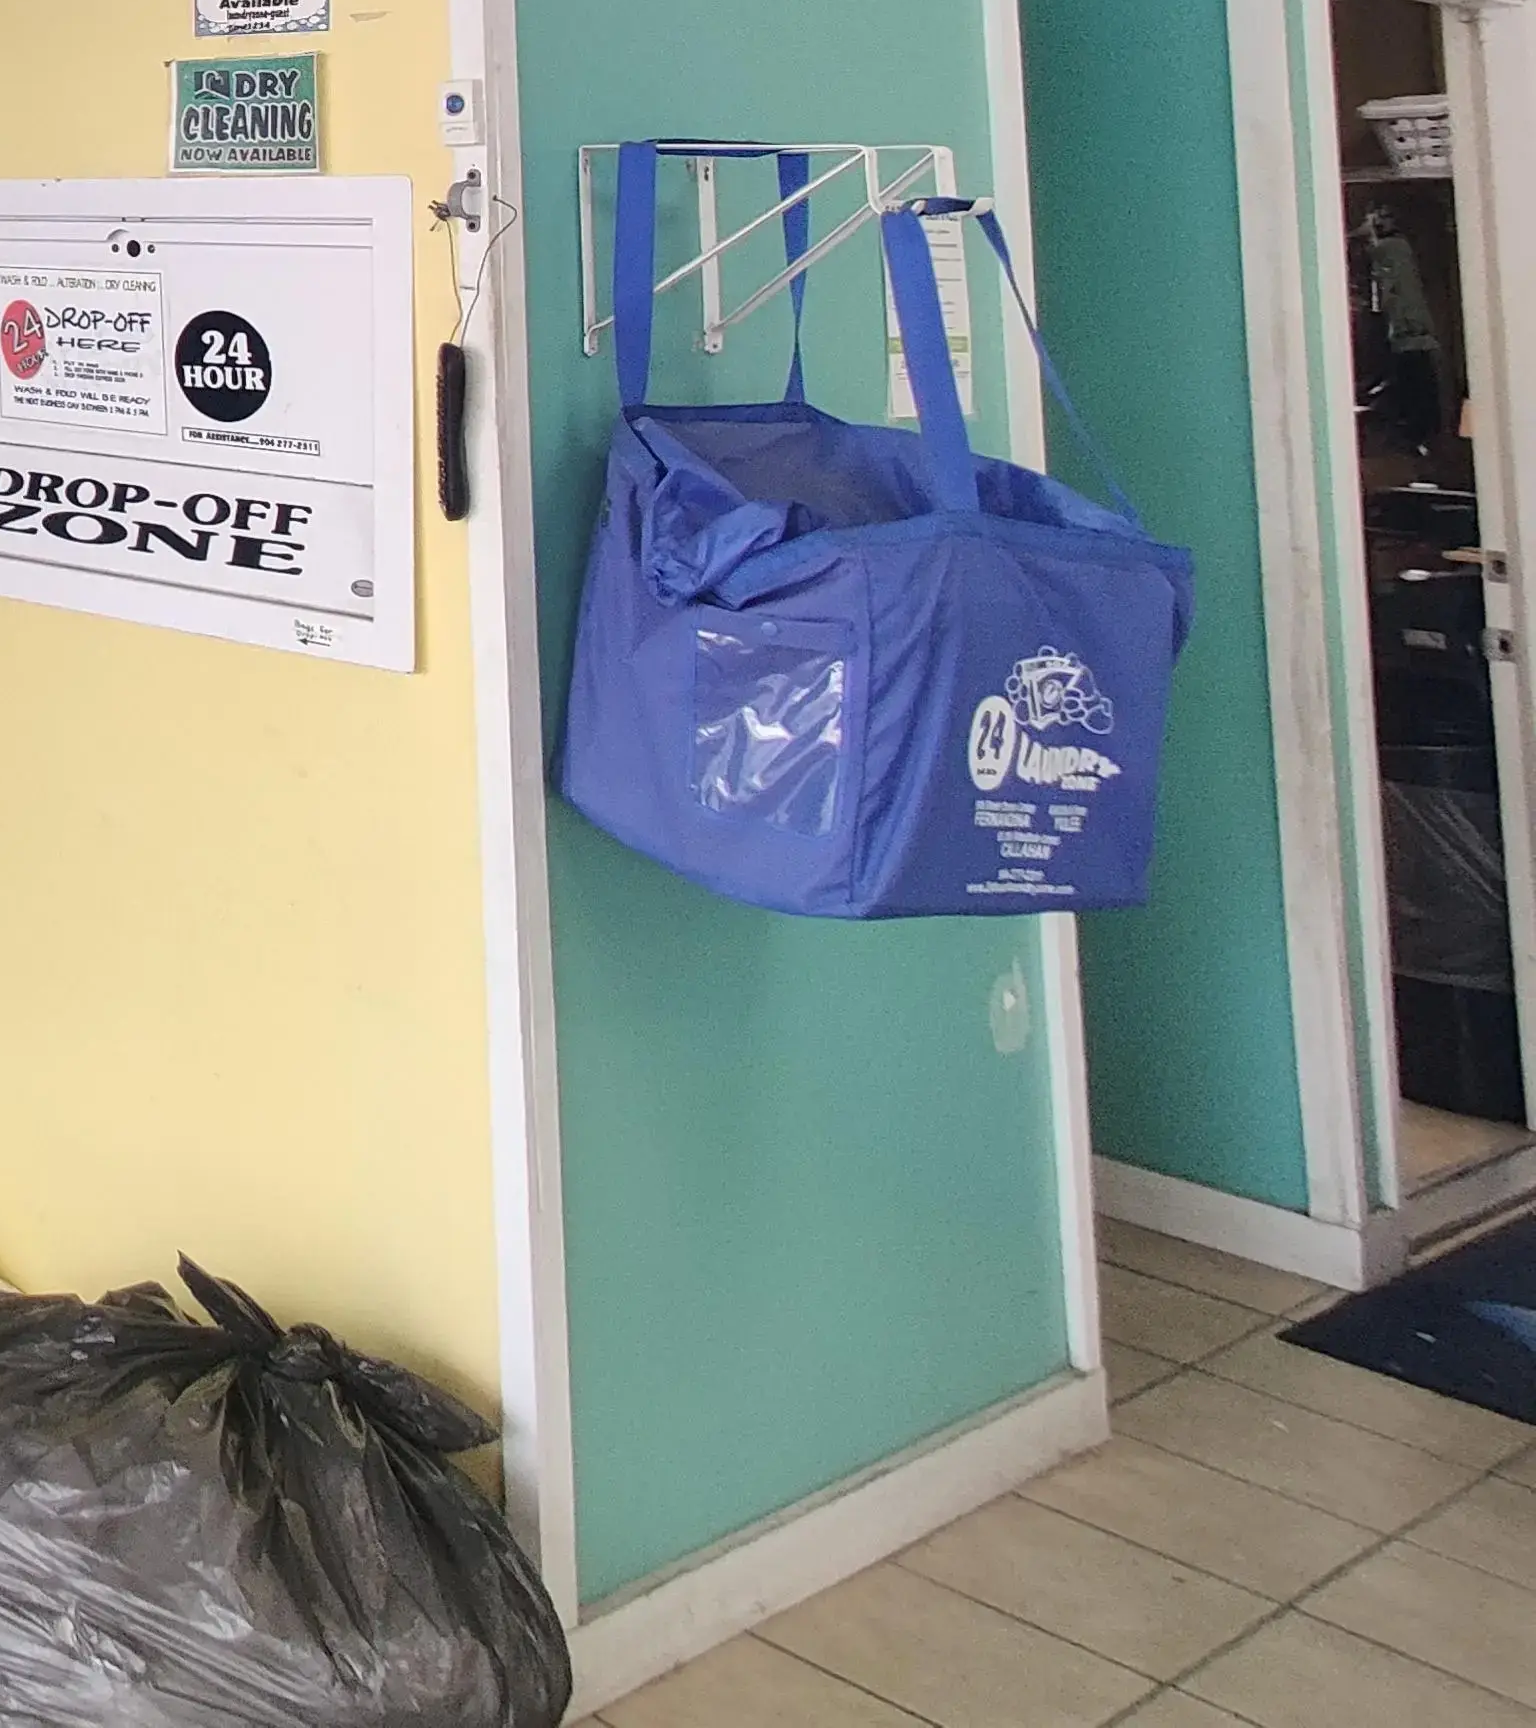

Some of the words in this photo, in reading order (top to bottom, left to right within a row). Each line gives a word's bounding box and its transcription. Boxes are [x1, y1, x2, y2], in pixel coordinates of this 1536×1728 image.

[233, 68, 300, 100] DRY
[182, 100, 314, 143] CLEANING
[180, 148, 223, 162] NOW
[227, 148, 312, 162] AVAILABLE
[0, 275, 20, 285] WASH
[31, 276, 48, 287] FOLD
[57, 278, 95, 290] ALTERATION
[105, 280, 120, 290] DRY
[123, 281, 156, 292] CLEANING
[4, 310, 44, 354] 24
[44, 307, 152, 333] DROP-OFF
[56, 336, 141, 353] HERE
[201, 329, 252, 365] 24
[182, 365, 266, 391] HOUR
[14, 385, 42, 394] WASH
[80, 392, 98, 400] WILL
[102, 394, 116, 402] BE
[119, 395, 151, 405] READY
[977, 709, 1006, 760] 24
